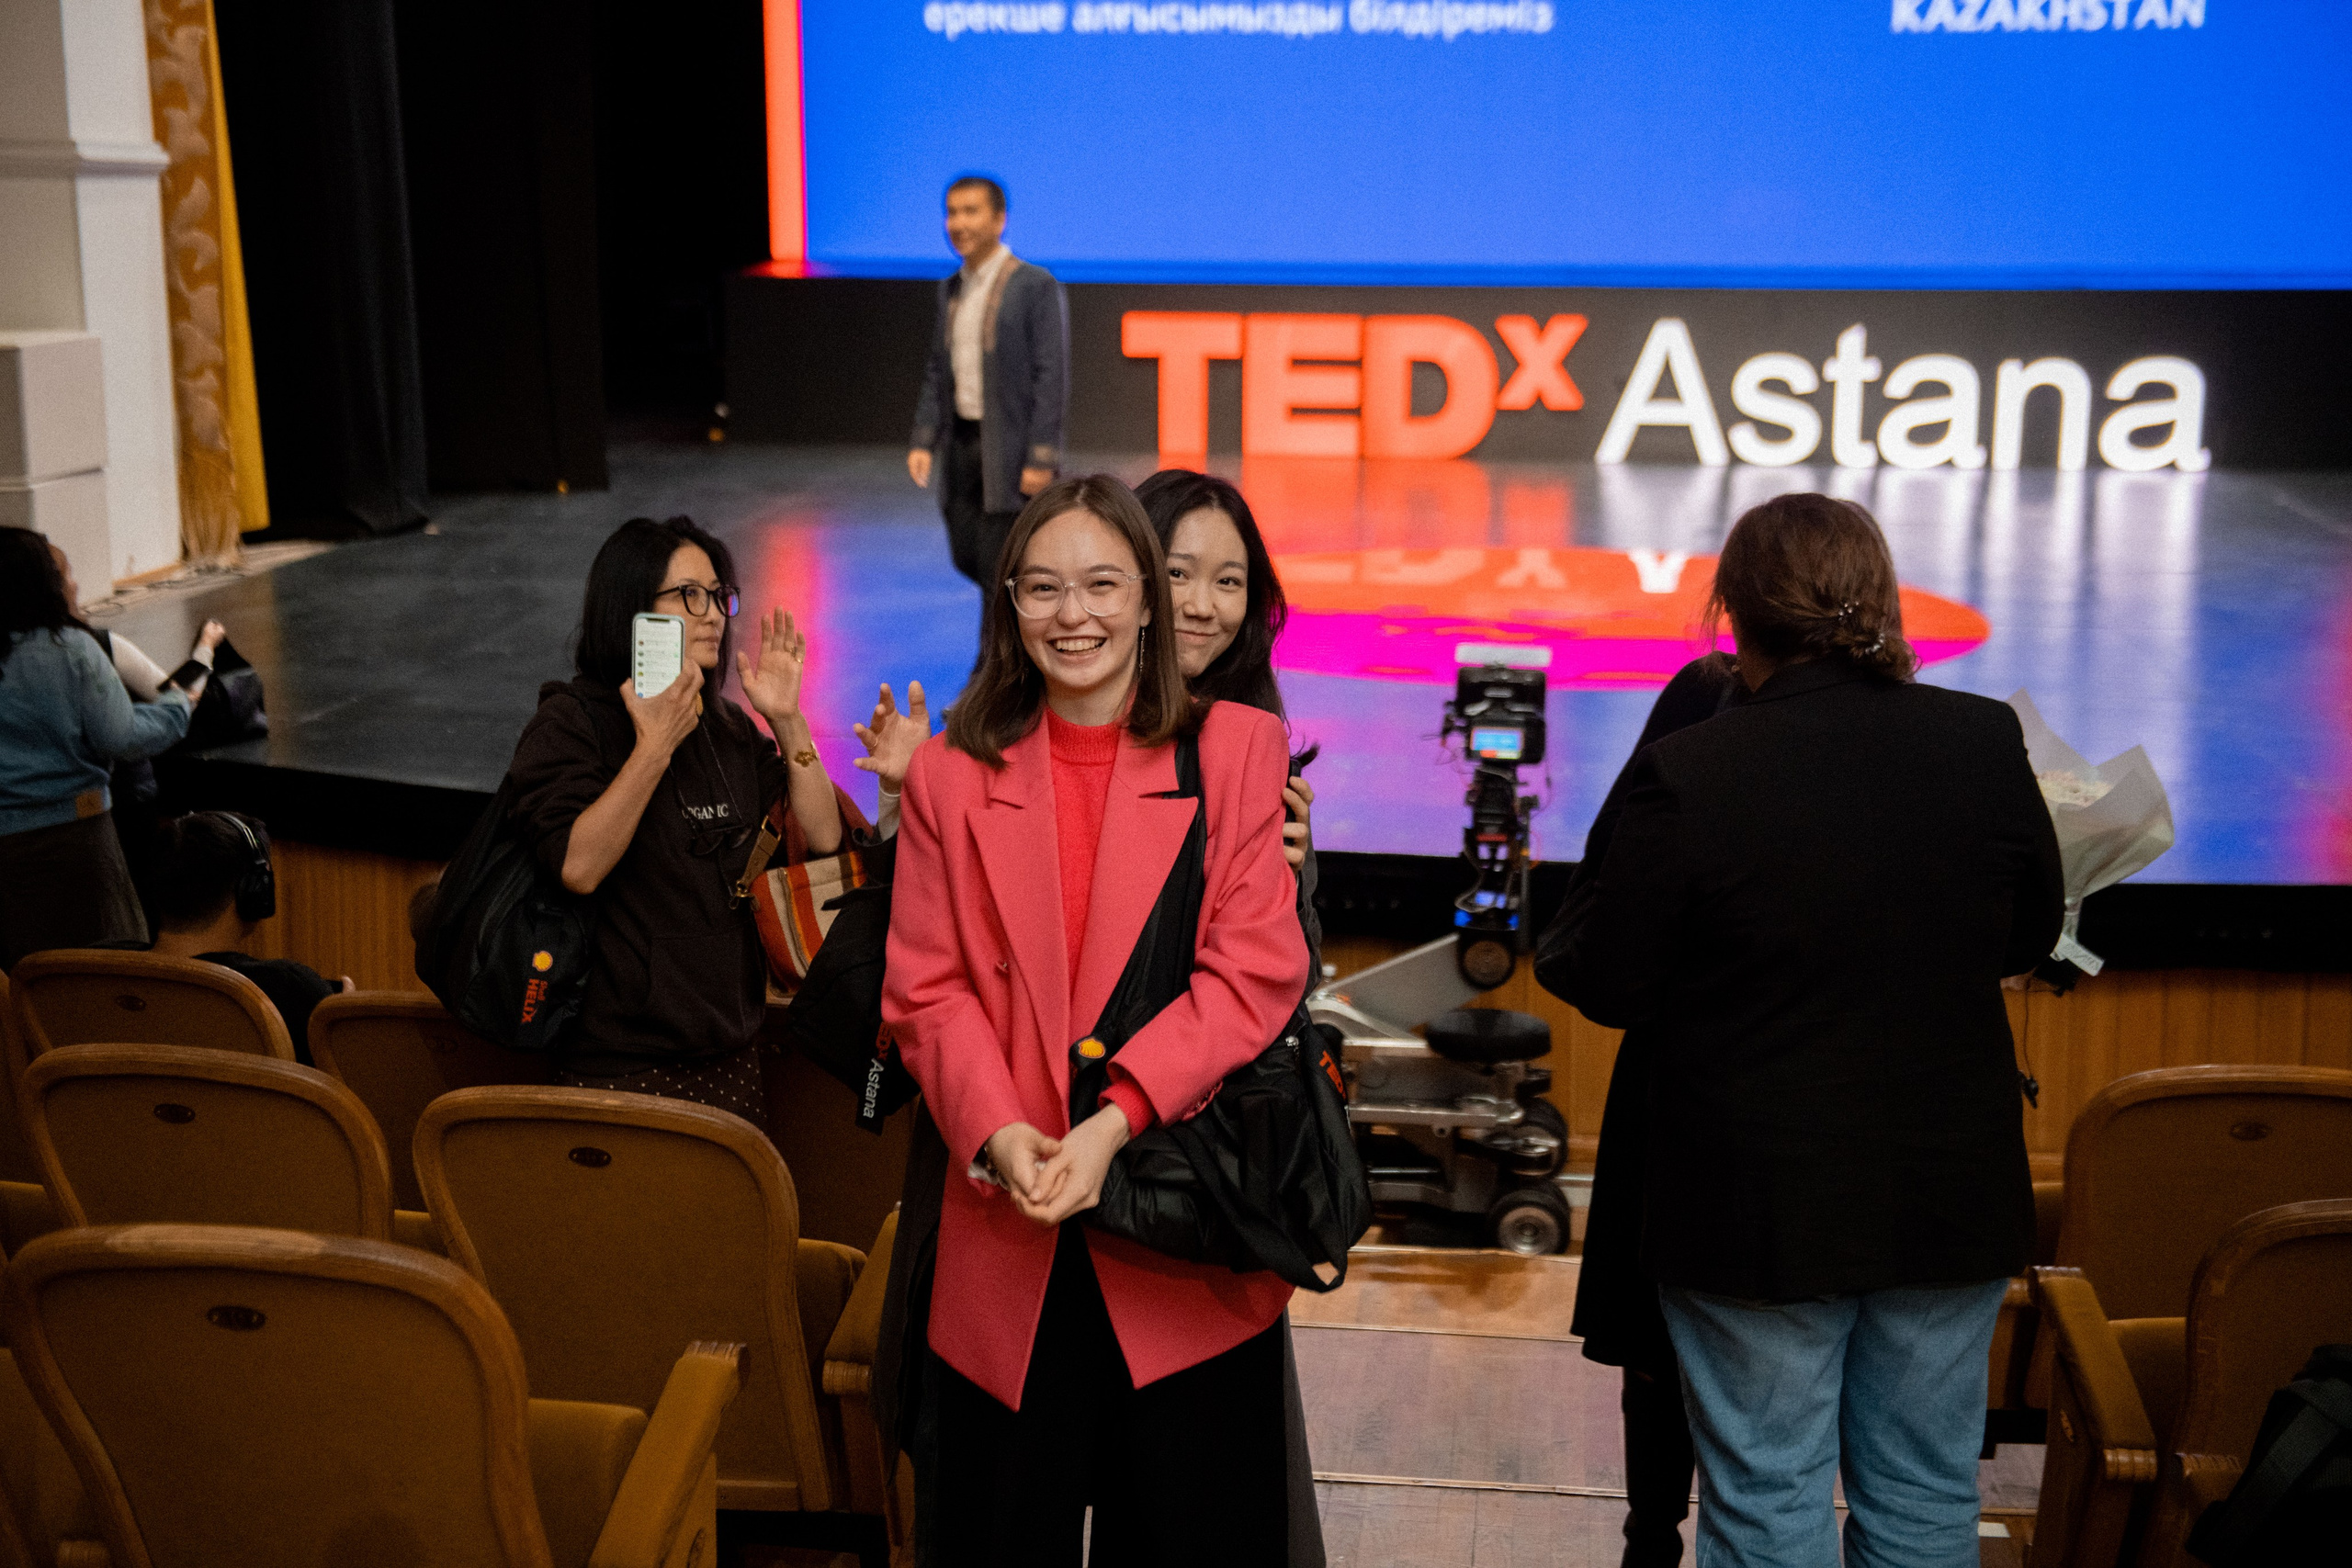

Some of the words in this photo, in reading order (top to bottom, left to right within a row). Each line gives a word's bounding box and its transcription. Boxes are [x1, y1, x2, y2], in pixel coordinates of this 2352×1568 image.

[1595, 317, 2211, 471] Astana
[521, 978, 540, 1023] HELIX
[863, 1057, 884, 1119] Astana
